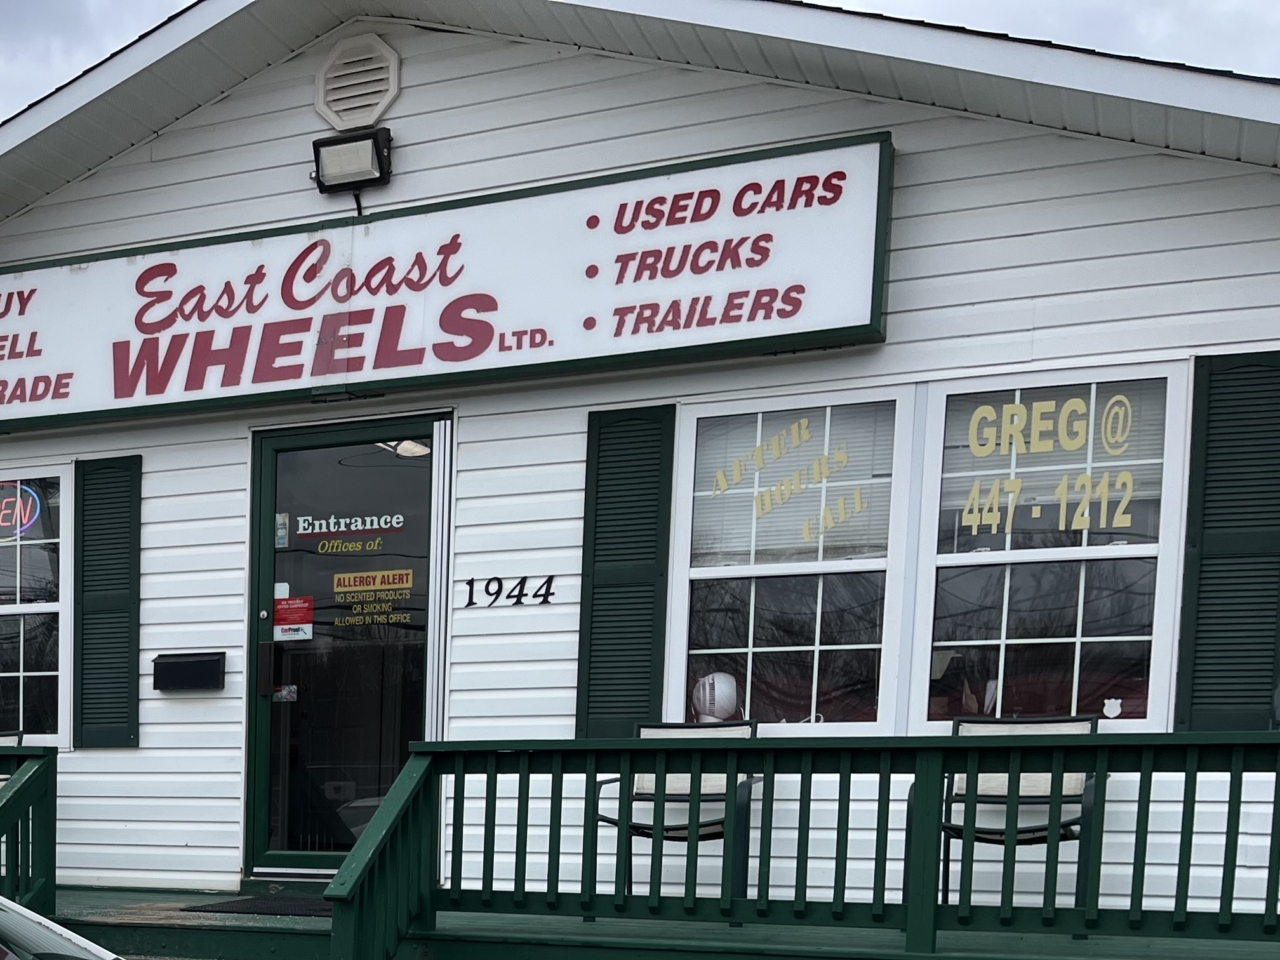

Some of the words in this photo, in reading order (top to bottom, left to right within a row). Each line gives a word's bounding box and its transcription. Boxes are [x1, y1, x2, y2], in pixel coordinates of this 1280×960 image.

[614, 188, 721, 235] USED
[732, 171, 847, 217] CARS
[134, 262, 269, 335] East
[280, 234, 464, 311] Coast
[614, 233, 774, 285] TRUCKS
[613, 284, 806, 337] TRAILERS
[112, 293, 498, 399] WHEELS
[498, 328, 554, 353] LTD.
[968, 397, 1088, 458] GREG
[1100, 394, 1132, 456] @
[711, 417, 812, 499] AFTER
[754, 442, 849, 519] HOURS
[296, 513, 405, 535] Entrance
[802, 487, 868, 542] CALL
[317, 539, 363, 554] Offices
[365, 537, 384, 550] of:
[335, 594, 345, 603] NO
[346, 592, 376, 603] SCENTED
[376, 590, 411, 601] PRODUCTS
[336, 575, 378, 589] ALLERGY
[380, 573, 411, 586] ALERT
[464, 574, 556, 608] 1944
[334, 616, 365, 627] ALLOWED
[365, 616, 372, 625] IN
[373, 615, 387, 625] THIS
[388, 613, 411, 624] OFFICE
[352, 604, 362, 614] OR
[363, 602, 393, 613] SMOKING
